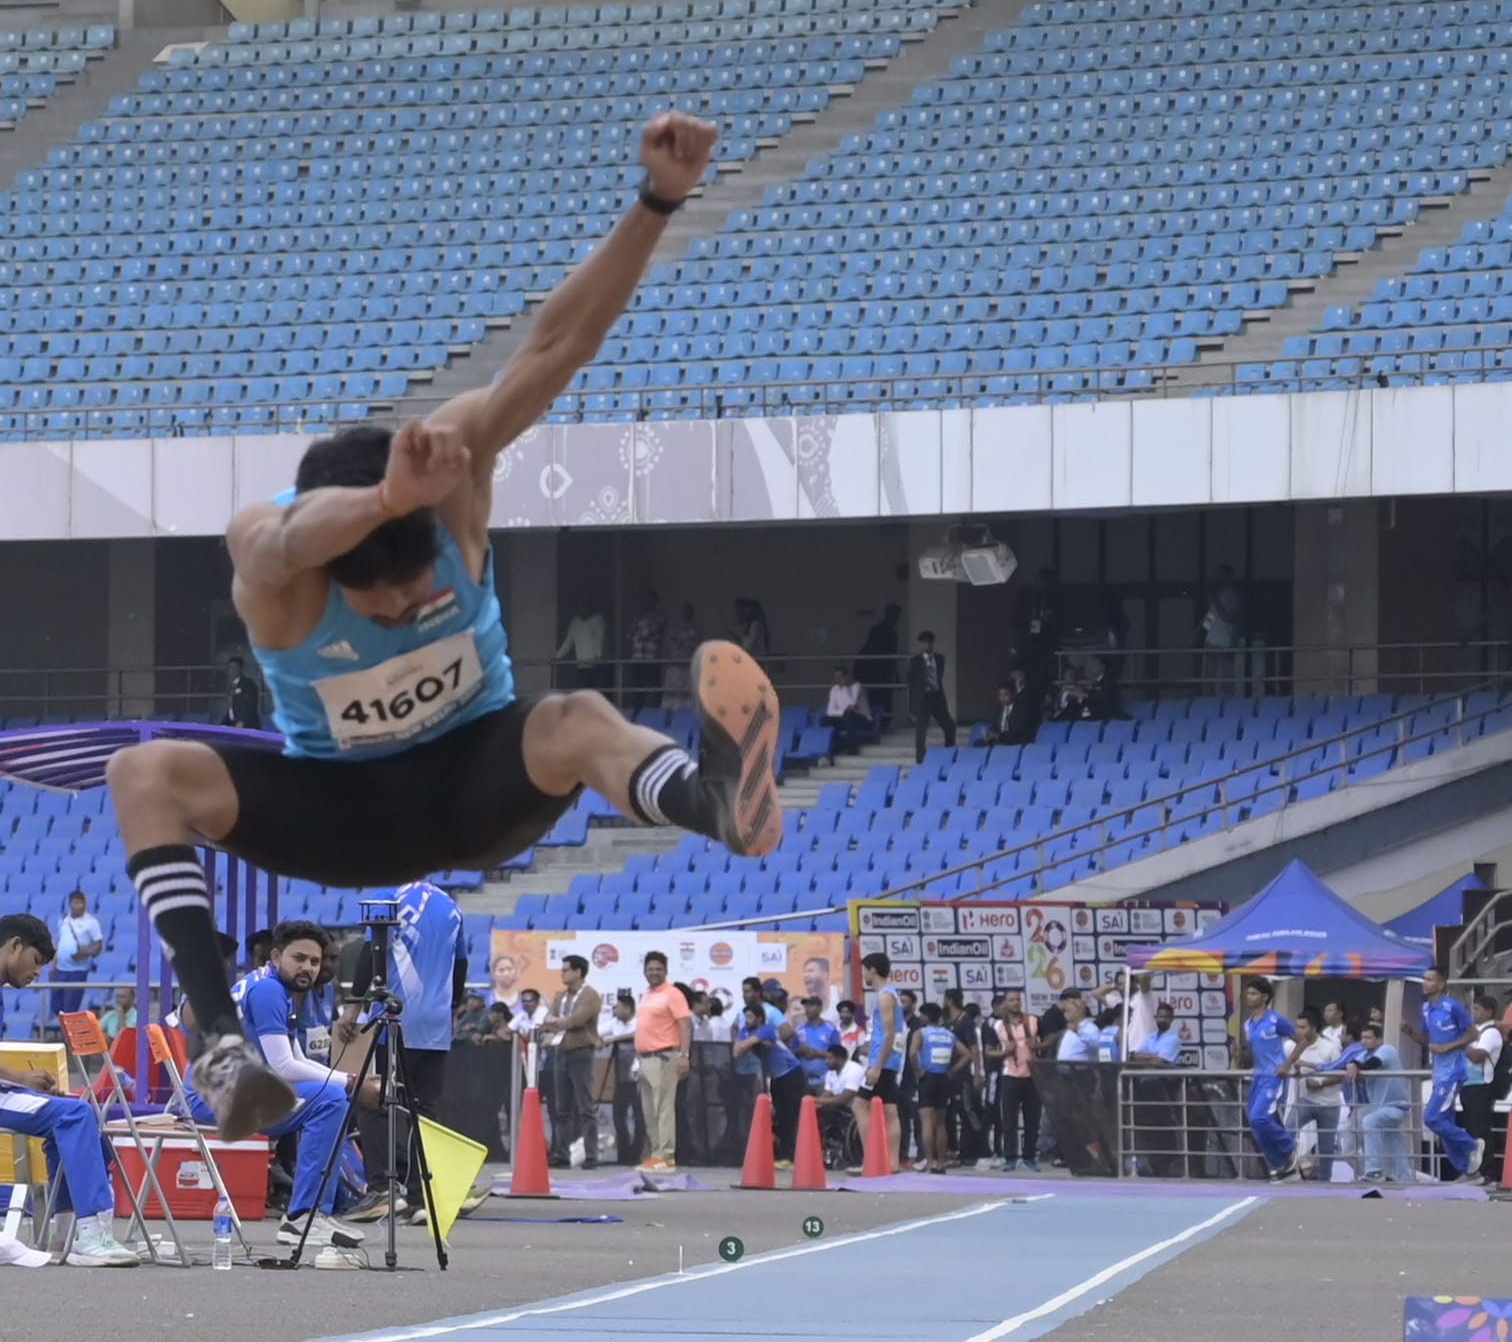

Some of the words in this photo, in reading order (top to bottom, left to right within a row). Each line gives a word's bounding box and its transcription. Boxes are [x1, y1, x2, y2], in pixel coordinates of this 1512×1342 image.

[340, 657, 464, 725] 41607
[979, 913, 1015, 928] Hero
[938, 942, 989, 956] IndianOil
[805, 1220, 821, 1233] 13
[726, 1241, 736, 1255] 3
